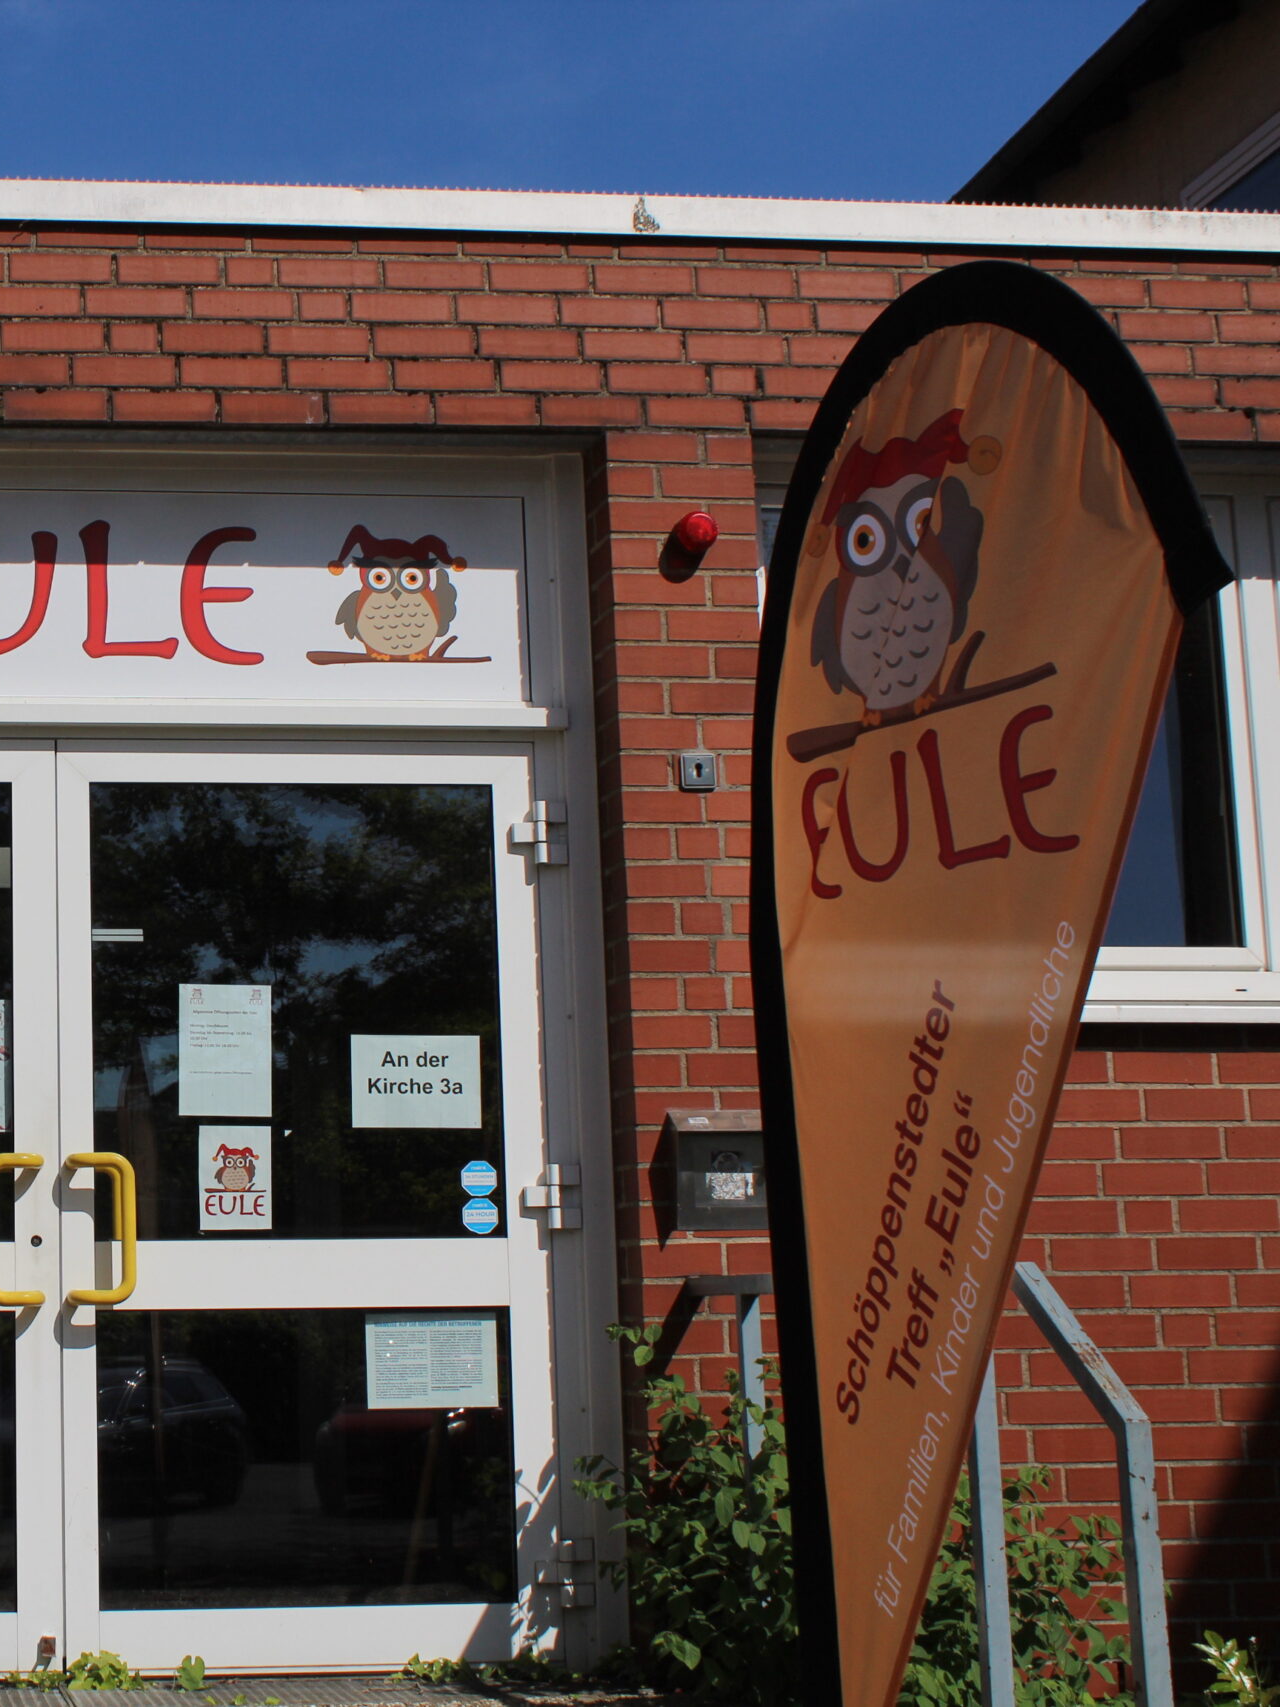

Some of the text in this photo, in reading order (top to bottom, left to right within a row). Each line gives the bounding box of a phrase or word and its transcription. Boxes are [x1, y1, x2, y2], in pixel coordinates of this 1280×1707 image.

[801, 704, 1081, 900] EULE
[367, 1077, 464, 1095] Kirche 3a
[381, 1051, 449, 1068] An der
[204, 1193, 266, 1217] EULE
[836, 978, 957, 1426] Schöppenstedter
[873, 921, 1076, 1618] für Familien, Kinder und Jugendliche
[885, 1267, 941, 1391] Treff
